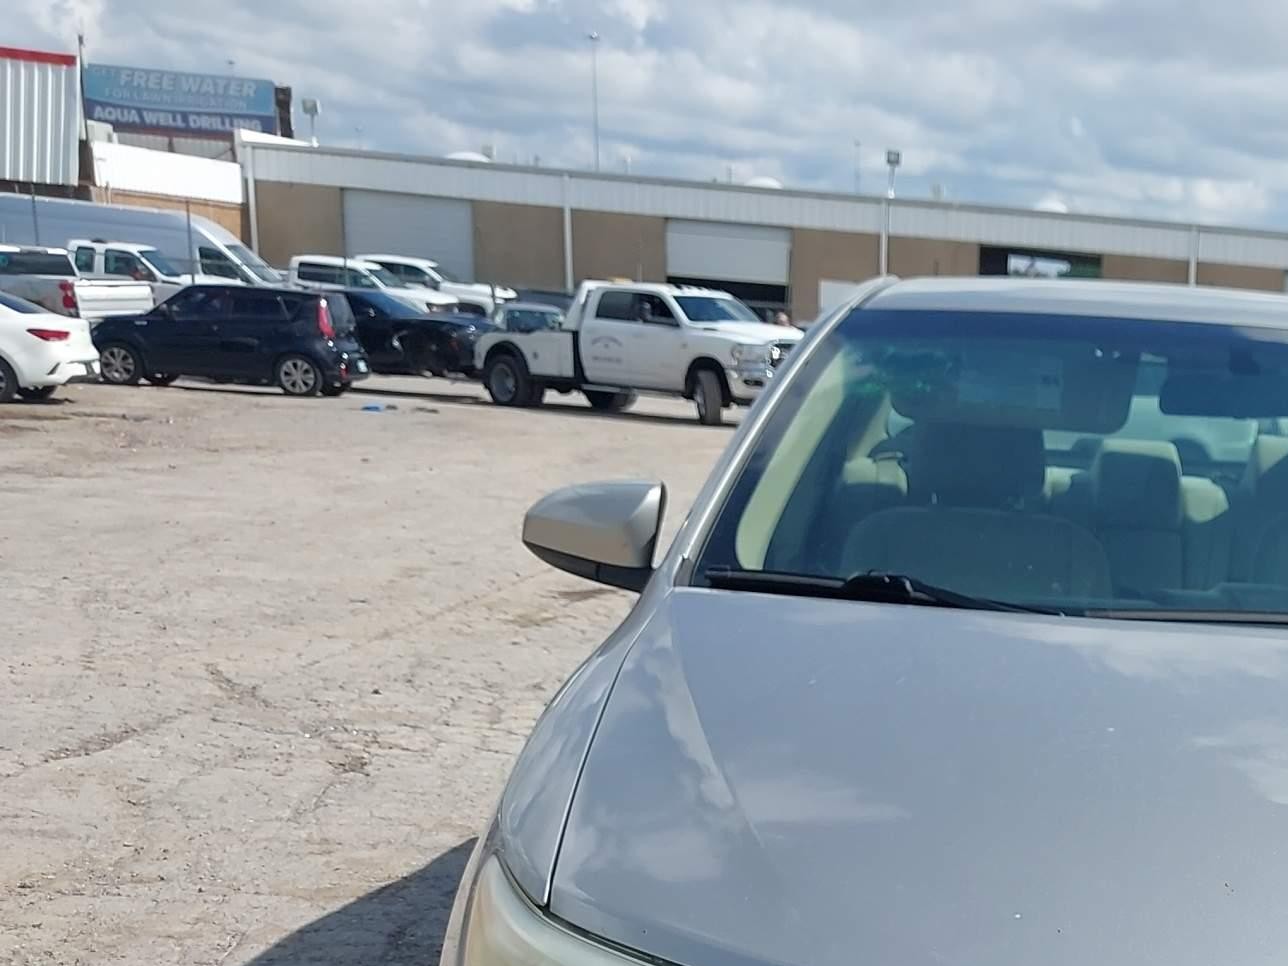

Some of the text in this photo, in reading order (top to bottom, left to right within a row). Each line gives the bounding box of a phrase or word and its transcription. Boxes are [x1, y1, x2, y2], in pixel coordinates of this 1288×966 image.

[104, 87, 129, 100] FOR
[119, 69, 176, 91] FREE
[180, 74, 257, 98] WATER
[93, 105, 262, 132] AQUA WELL DRILLING
